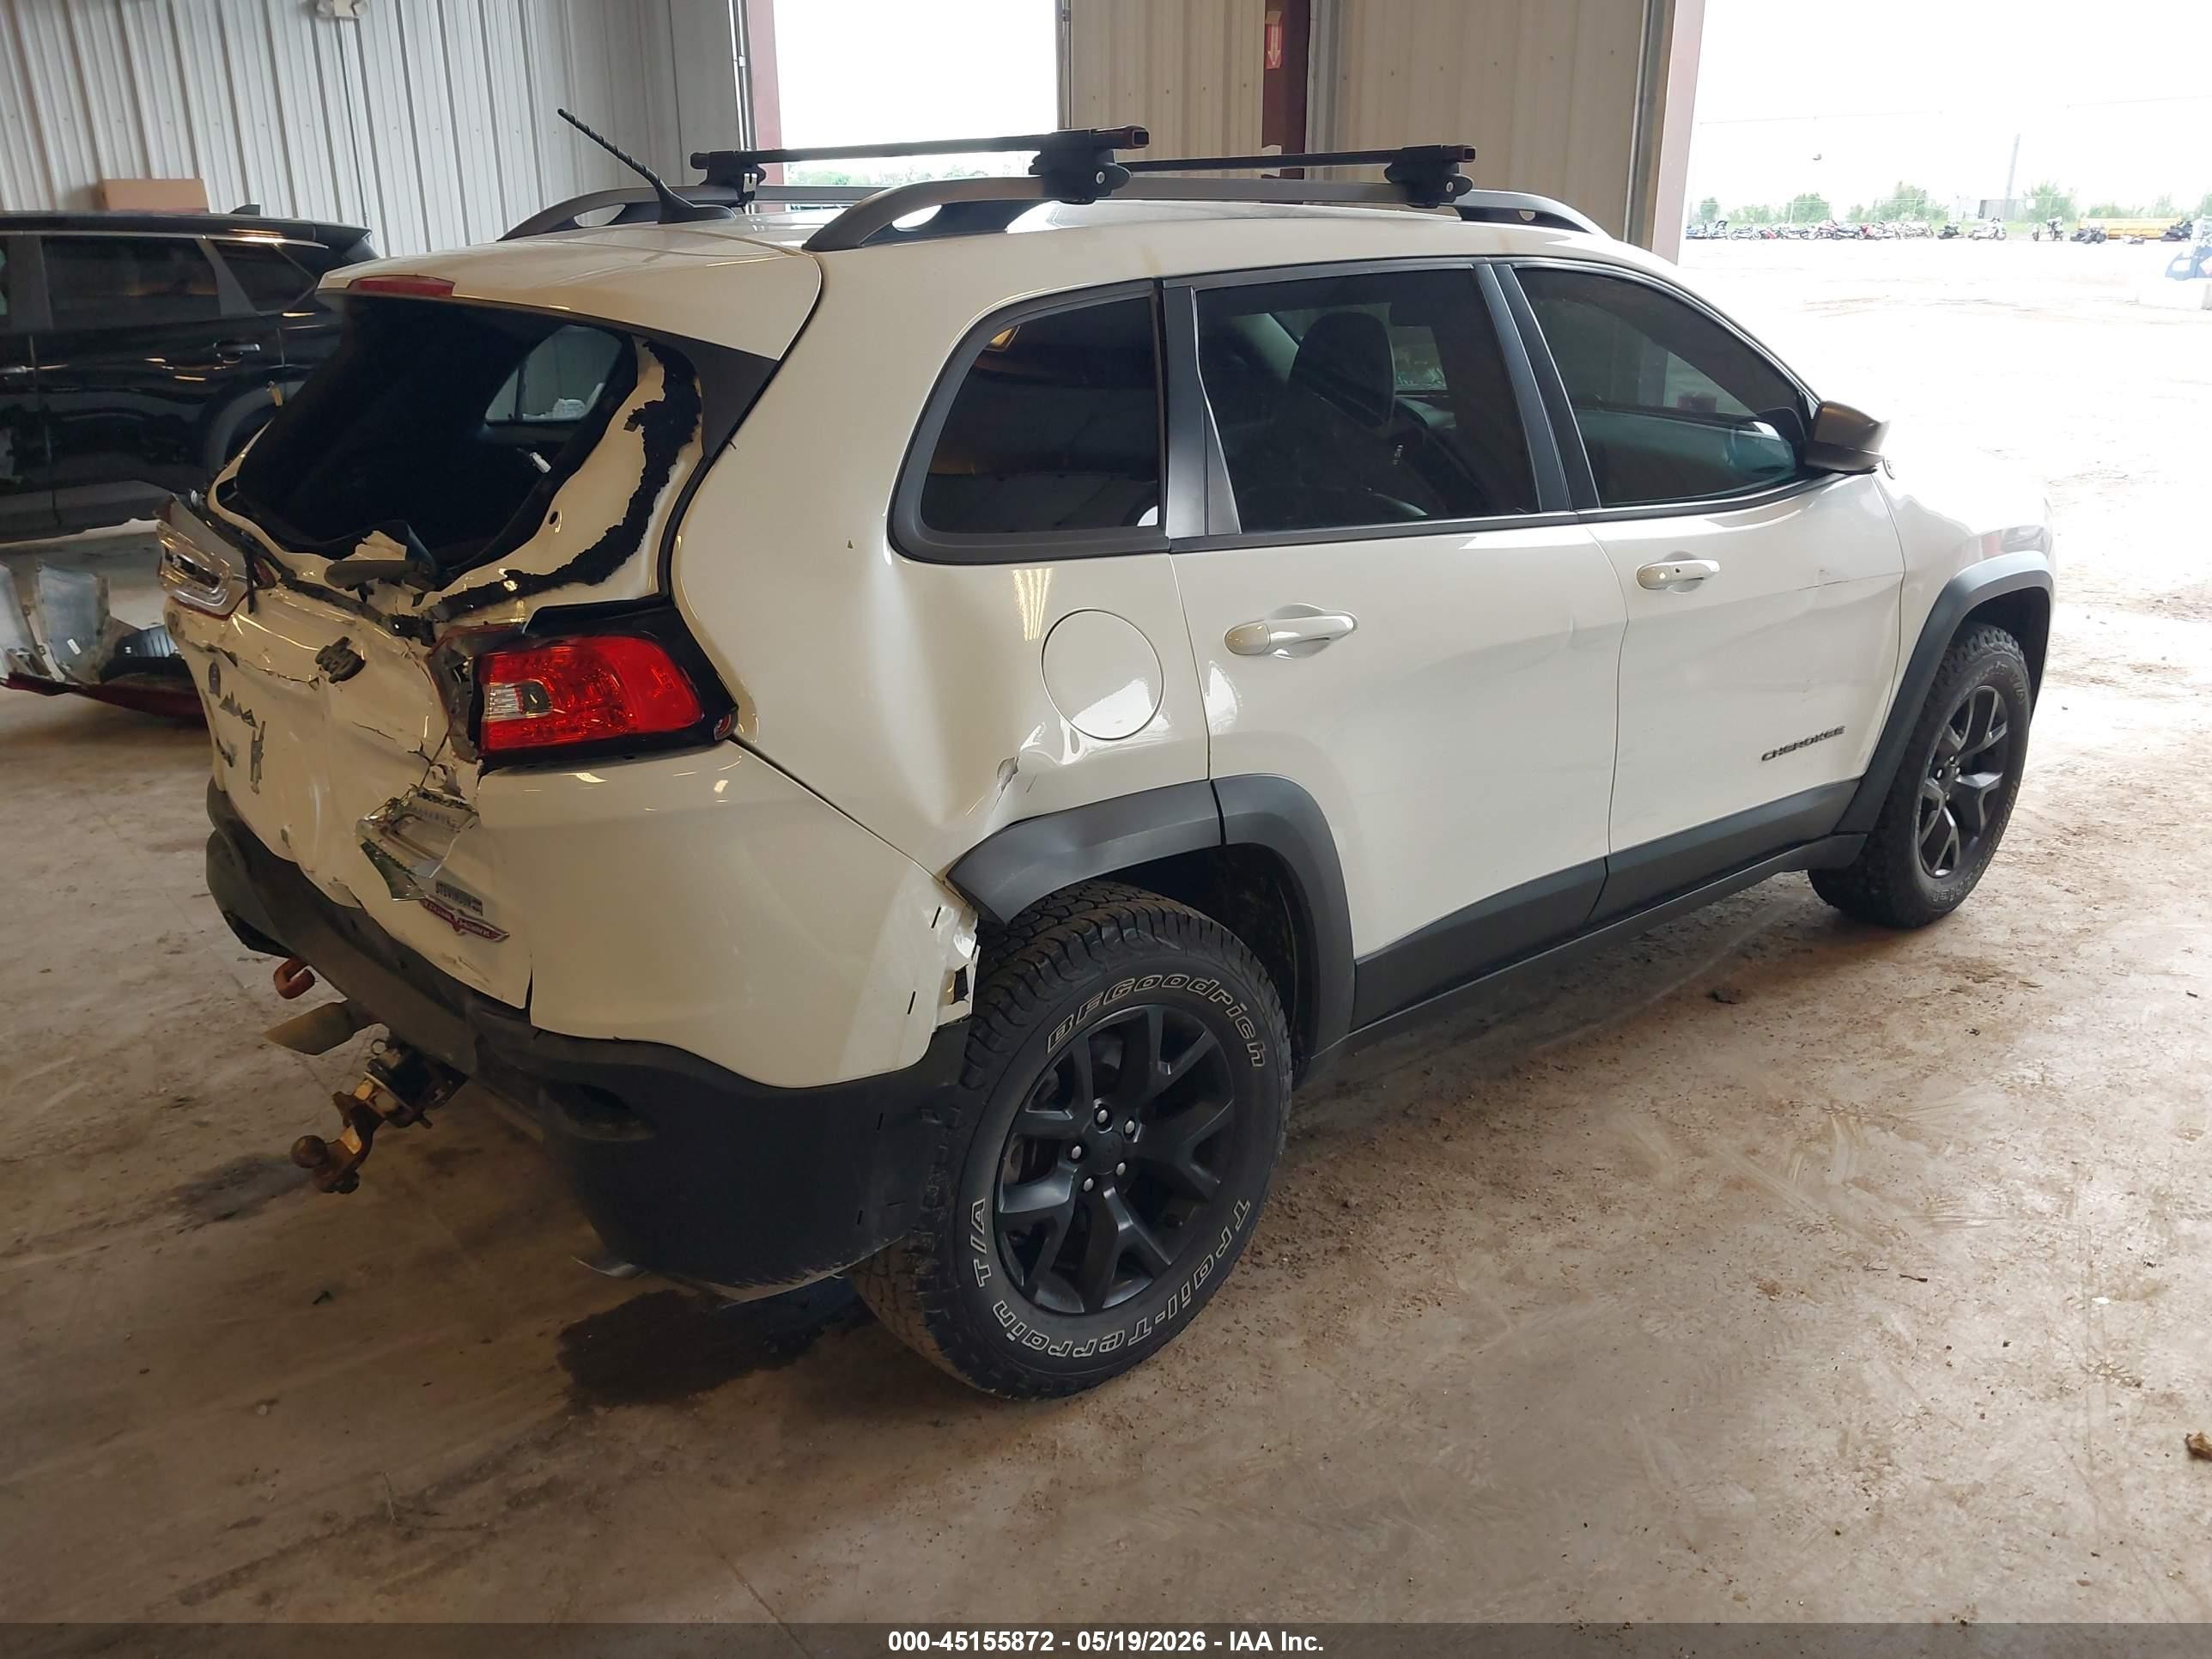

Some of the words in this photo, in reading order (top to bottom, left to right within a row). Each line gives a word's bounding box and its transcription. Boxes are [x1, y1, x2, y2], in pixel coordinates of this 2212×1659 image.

[1761, 725, 1845, 762] CHEROKEE
[1047, 974, 1266, 1067] BFGoodrich
[970, 1198, 992, 1288] T/A
